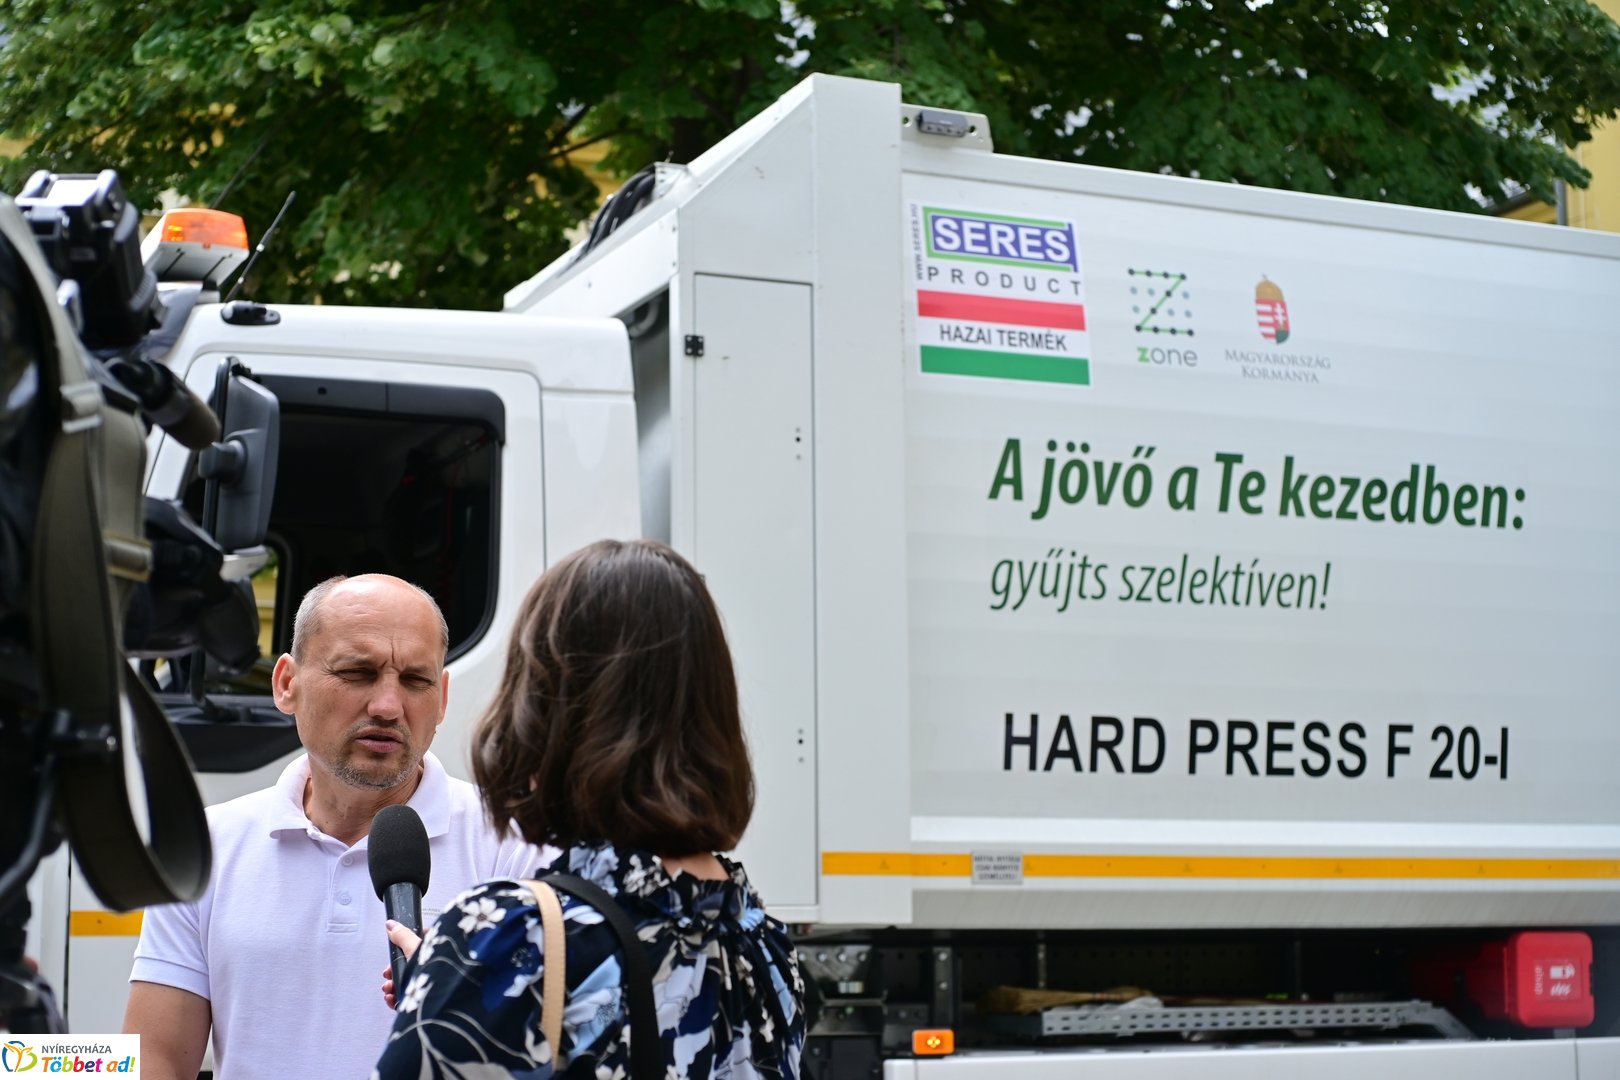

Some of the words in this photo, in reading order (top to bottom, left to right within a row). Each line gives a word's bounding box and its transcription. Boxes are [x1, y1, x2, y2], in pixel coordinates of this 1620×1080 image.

[934, 217, 1071, 263] SERES
[927, 265, 1081, 296] PRODUCT
[940, 324, 992, 345] HAZAI
[997, 328, 1068, 351] TERMÉK
[1136, 346, 1198, 367] zone
[988, 437, 1024, 501] A
[1031, 438, 1157, 520] jövő
[1167, 466, 1199, 512] a
[1214, 451, 1267, 516] Te
[1279, 455, 1526, 530] kezedben:
[990, 547, 1108, 613] gyűjts
[1118, 553, 1333, 610] szelektíven!
[1003, 712, 1167, 775] HARD
[1187, 718, 1368, 780] PRESS
[1386, 723, 1414, 779] F
